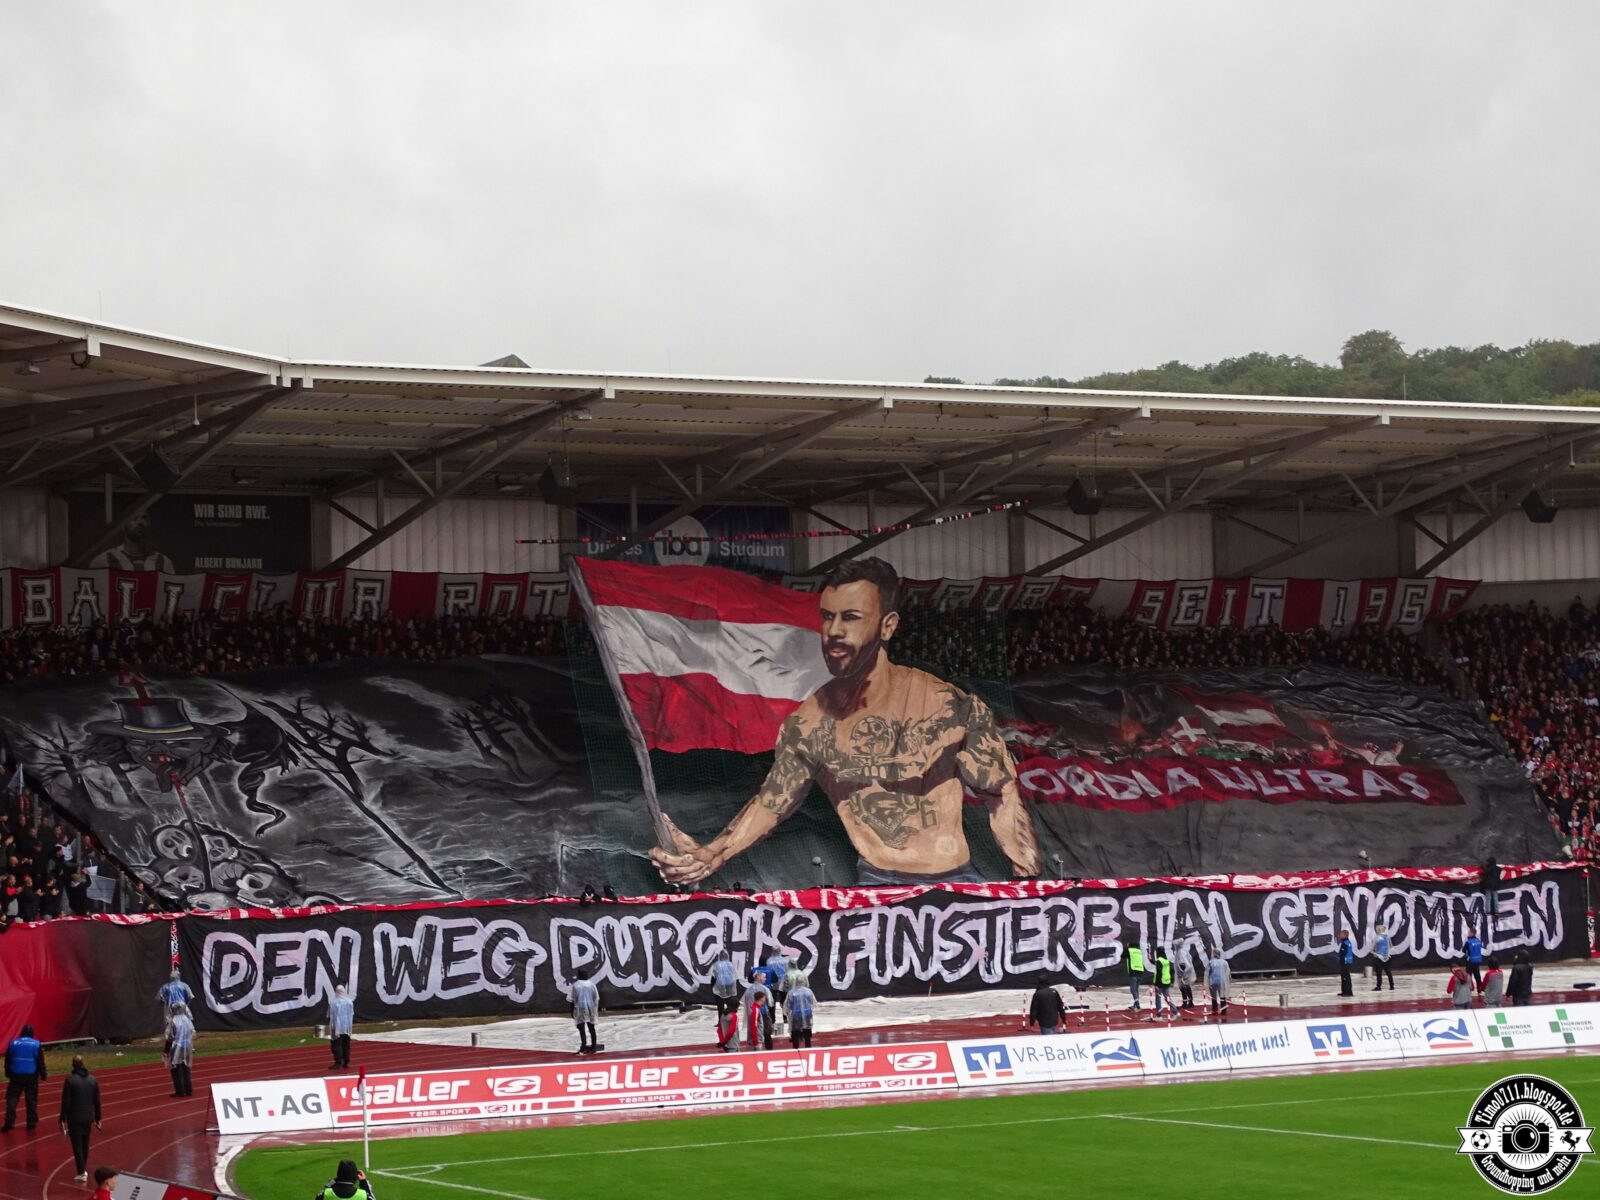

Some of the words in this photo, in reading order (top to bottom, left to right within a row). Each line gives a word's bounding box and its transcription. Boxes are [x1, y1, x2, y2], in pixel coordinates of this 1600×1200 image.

[194, 504, 215, 519] WIR
[217, 504, 243, 519] SIND
[245, 505, 271, 520] RWE.
[719, 541, 786, 556] Studium
[443, 580, 570, 618] ROT
[1135, 585, 1289, 628] SEIT
[1208, 765, 1432, 802] ULTRAS
[202, 928, 361, 1016] DEN
[372, 915, 548, 1003] WEG
[829, 896, 1125, 992] FINSTERE
[1123, 889, 1264, 975] TAL
[1263, 880, 1564, 962] GENOMMEN
[1160, 1048, 1189, 1069] Wir
[1192, 1037, 1259, 1064] kümmern
[1261, 1026, 1291, 1052] uns!
[1352, 1022, 1423, 1042] VR-Bank
[1012, 1043, 1089, 1064] VR-Bank
